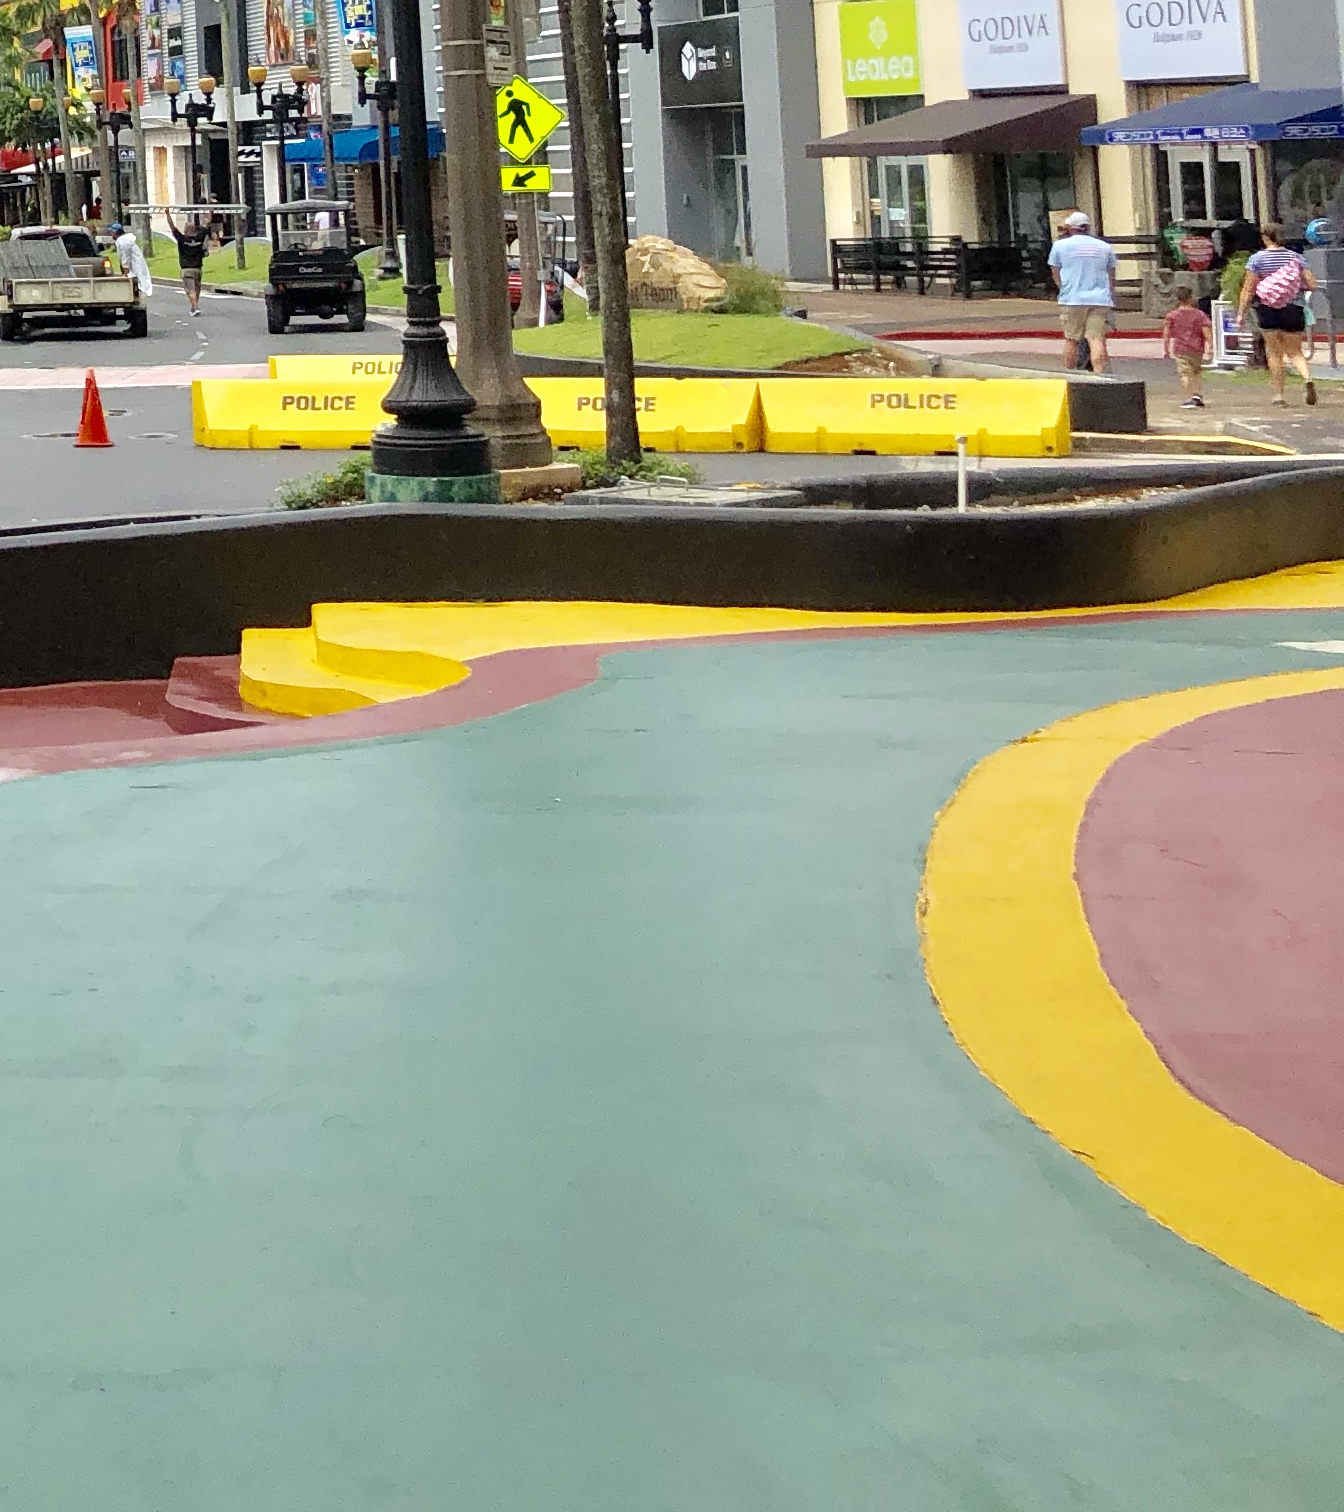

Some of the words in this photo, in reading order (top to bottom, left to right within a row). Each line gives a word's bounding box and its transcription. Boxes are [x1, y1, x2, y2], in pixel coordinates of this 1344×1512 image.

[967, 13, 1050, 43] GODIVA
[352, 361, 403, 376] POLIC
[282, 395, 357, 411] POLICE
[577, 397, 657, 412] POCE
[871, 393, 957, 410] POLICE
